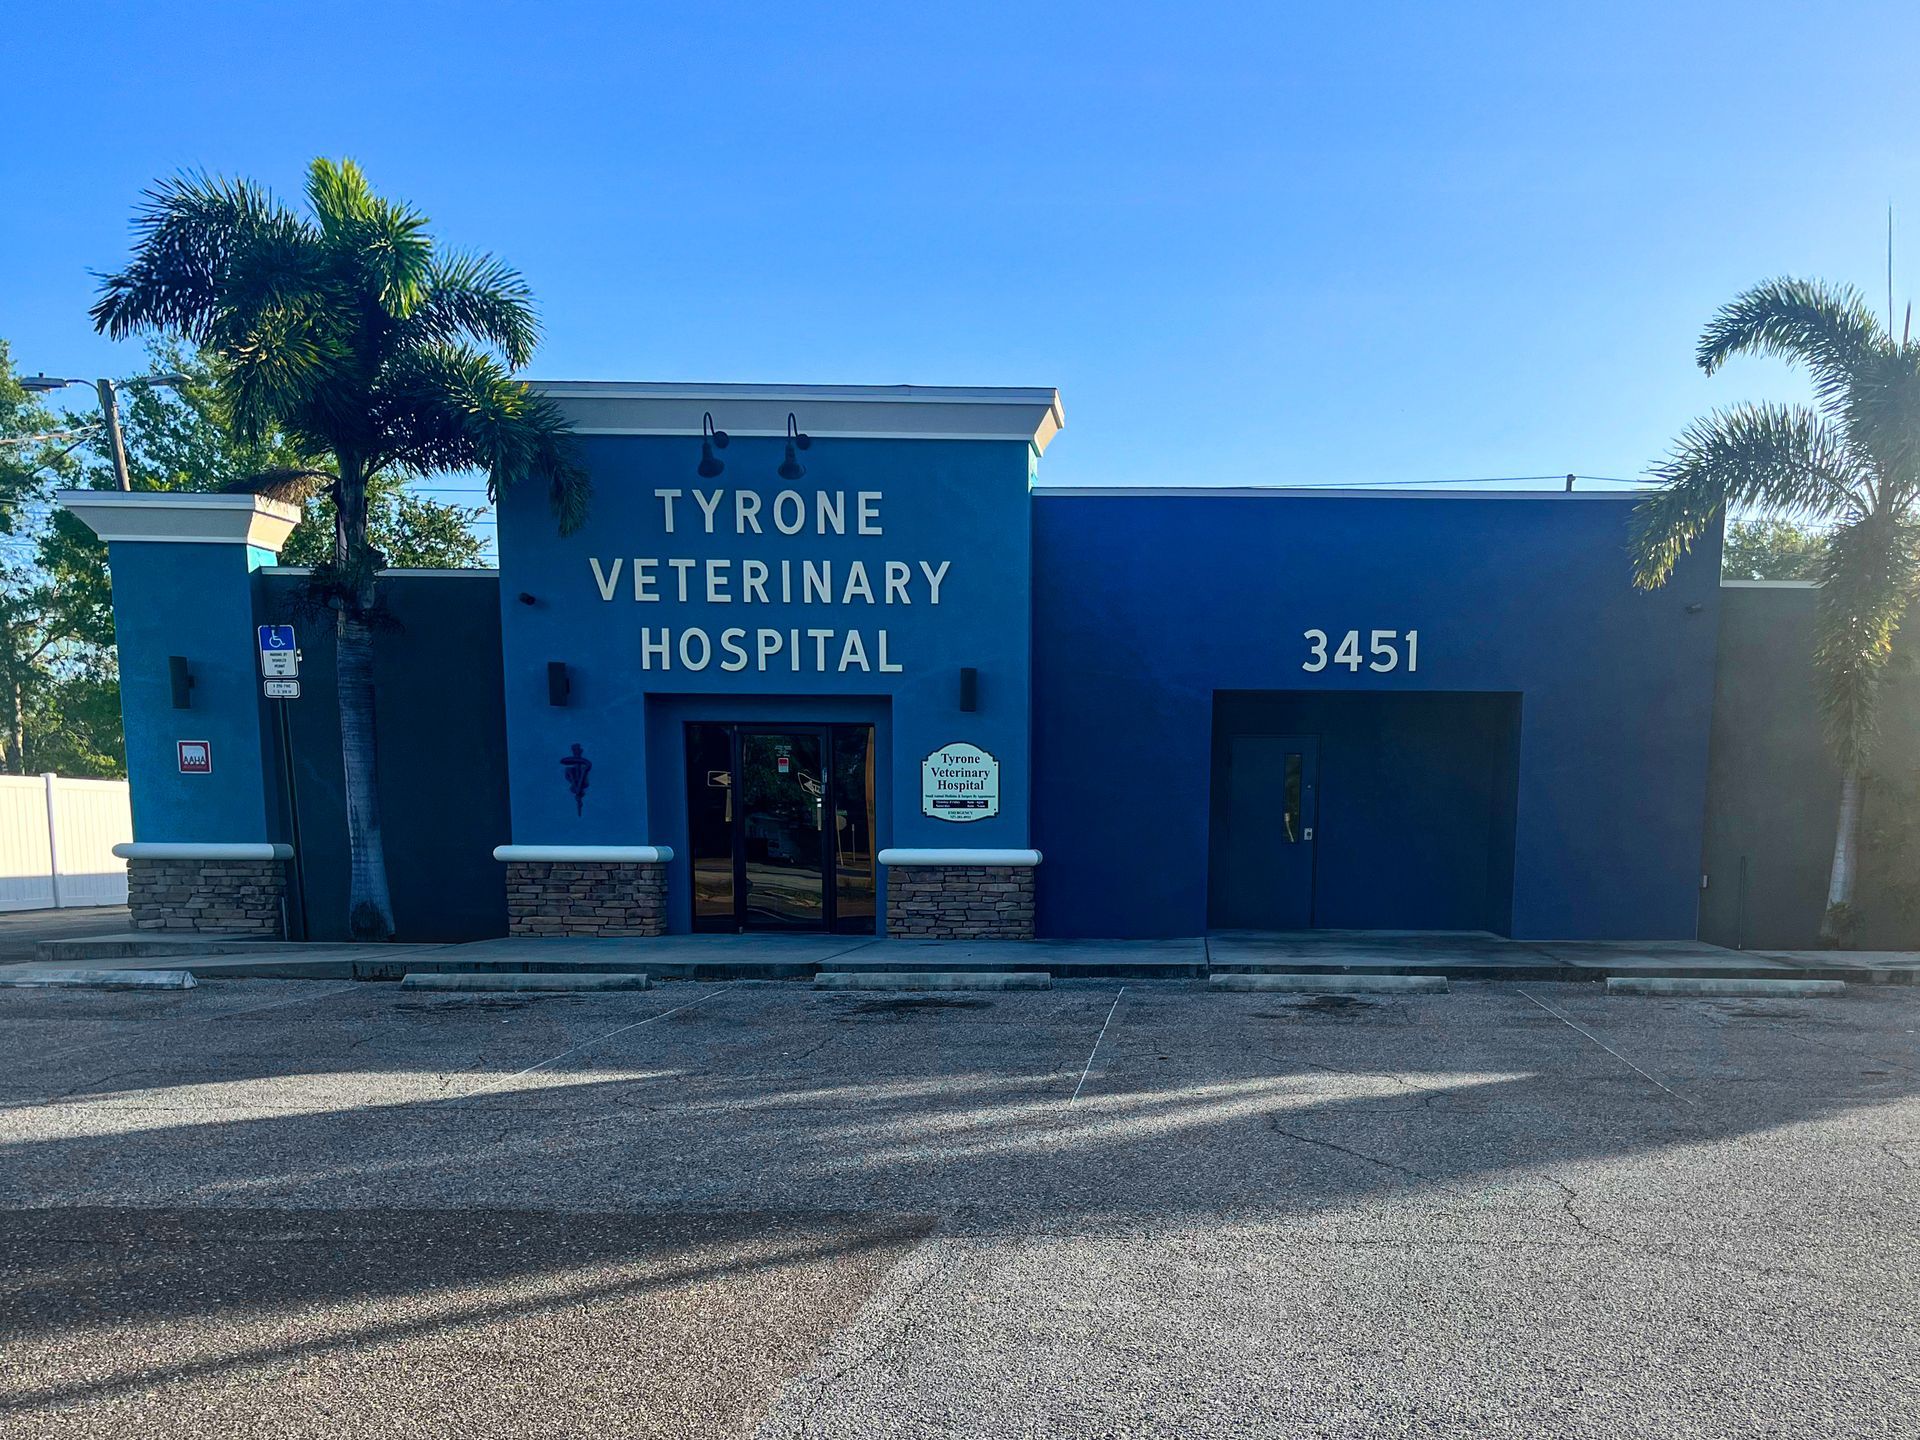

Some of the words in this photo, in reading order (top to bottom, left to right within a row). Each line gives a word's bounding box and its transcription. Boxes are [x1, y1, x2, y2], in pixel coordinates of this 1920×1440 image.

[655, 489, 883, 535] TYRONE
[589, 557, 951, 604] VETERINARY
[641, 627, 903, 672] HOSPITAL
[1302, 628, 1418, 673] 3451
[183, 755, 206, 765] AAHA
[931, 767, 990, 780] Veterinary
[941, 753, 980, 766] Tyrone
[938, 780, 984, 793] Hospital
